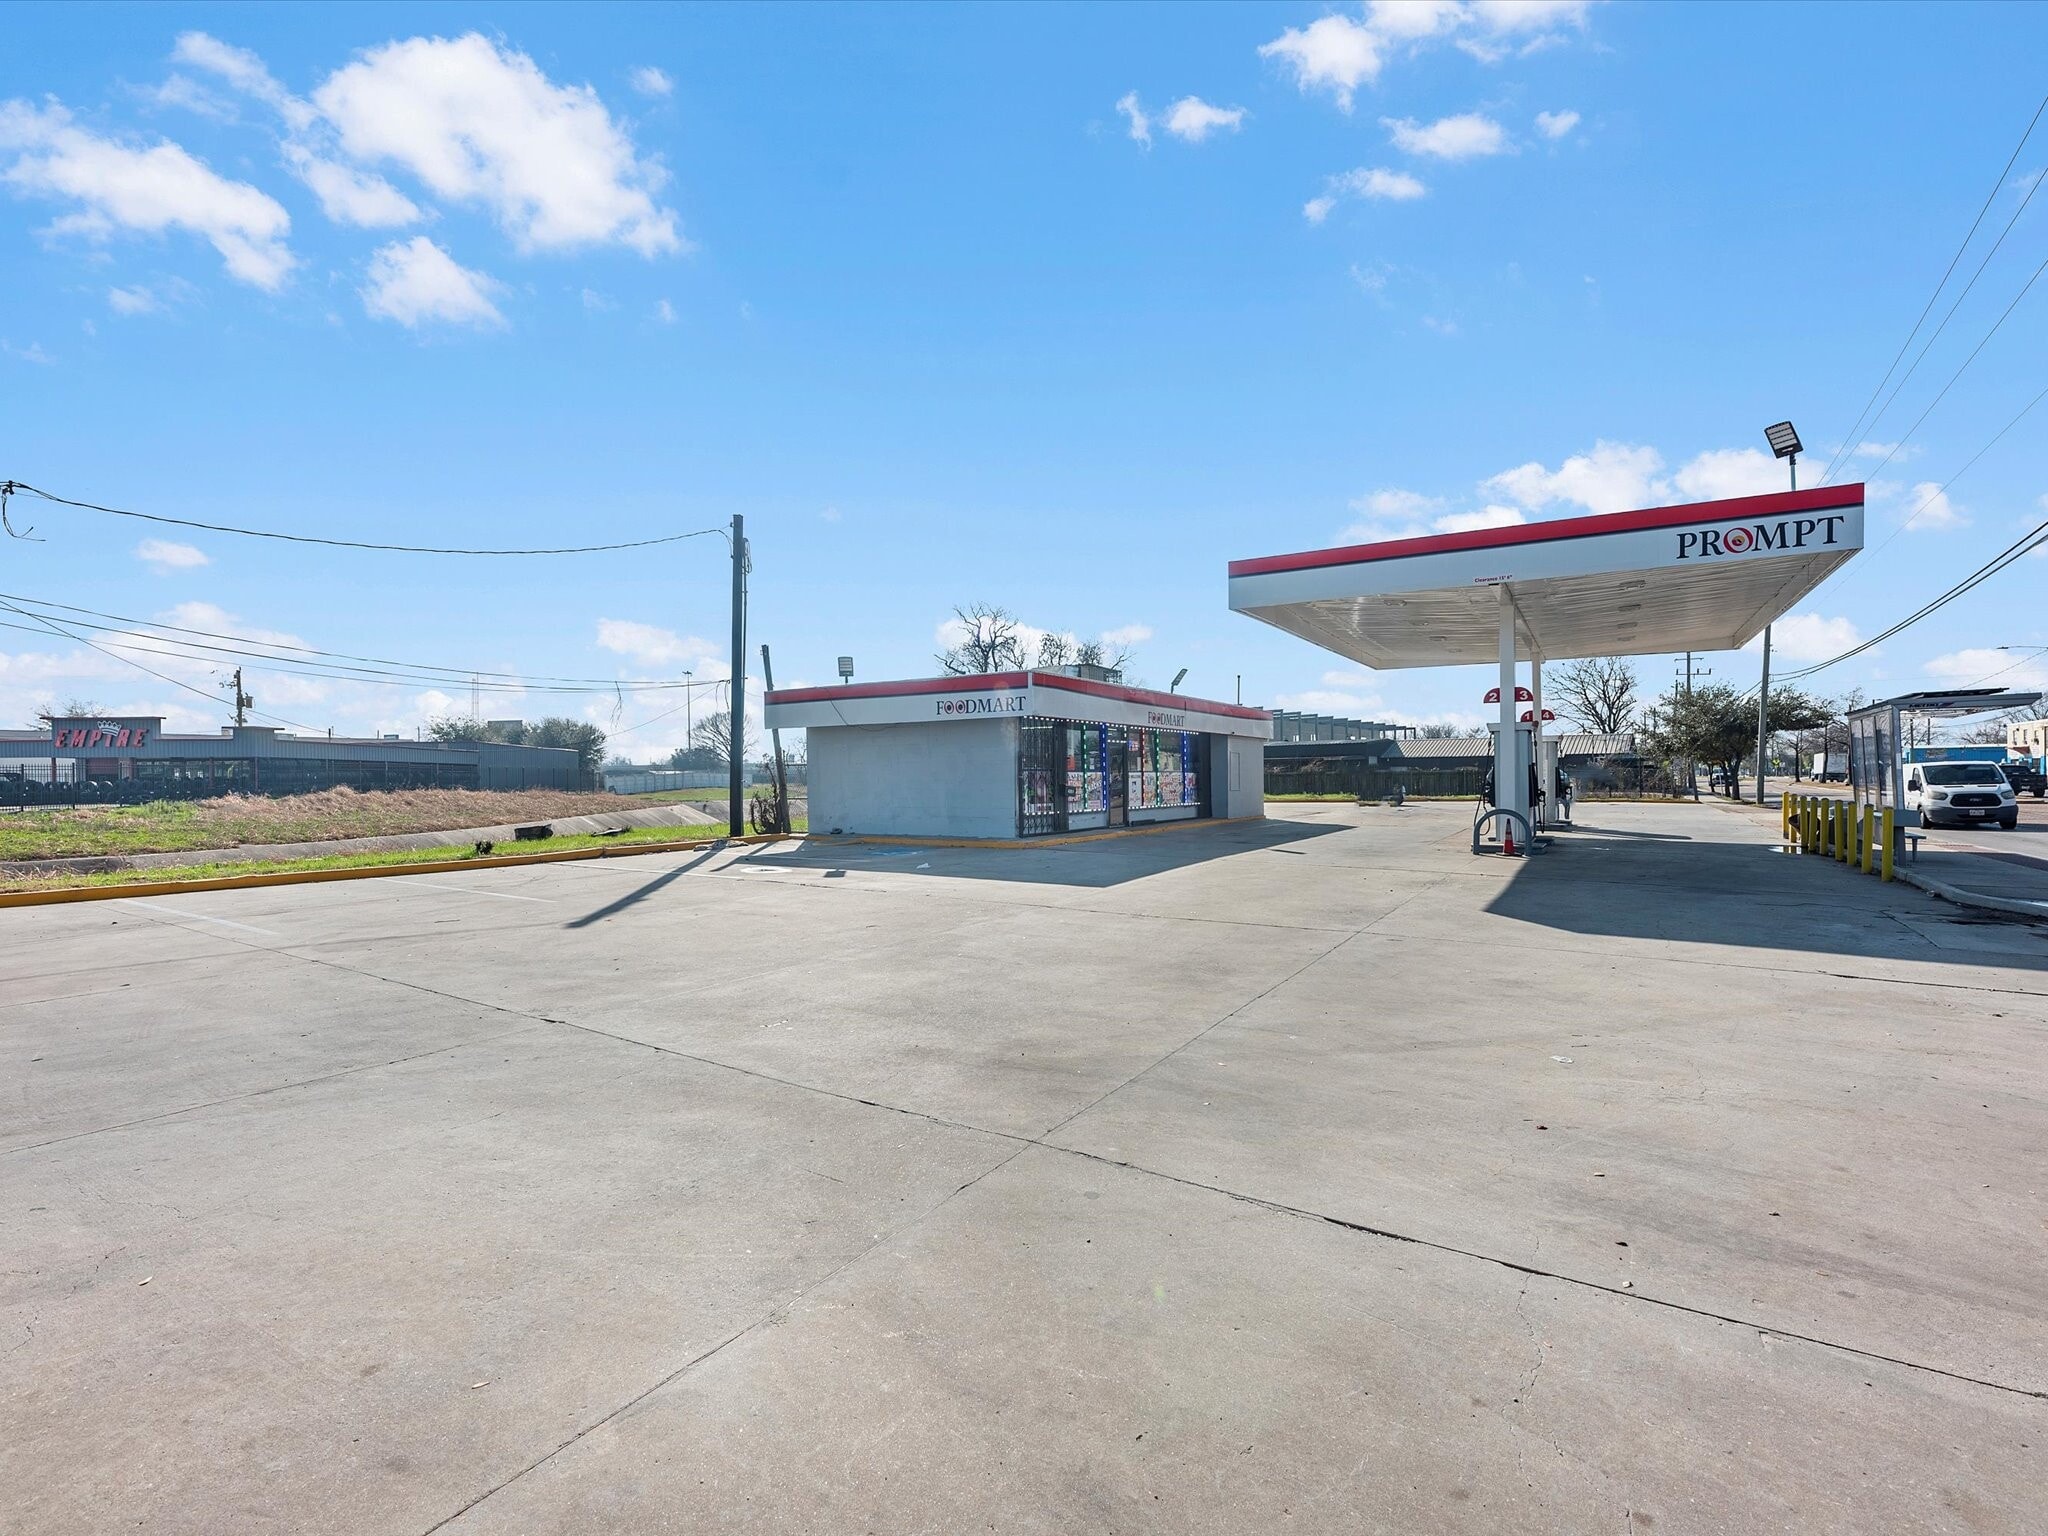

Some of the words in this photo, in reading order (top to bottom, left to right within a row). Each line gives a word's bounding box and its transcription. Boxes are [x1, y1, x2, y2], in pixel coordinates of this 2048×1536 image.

[1676, 516, 1845, 559] PROMPT
[1488, 692, 1498, 702] 2
[1519, 690, 1529, 700] 3
[936, 696, 1026, 715] FOODMART
[1147, 711, 1185, 727] FOODMART
[1524, 712, 1531, 720] 1
[1542, 711, 1550, 719] 4
[55, 728, 148, 748] EMPIRE
